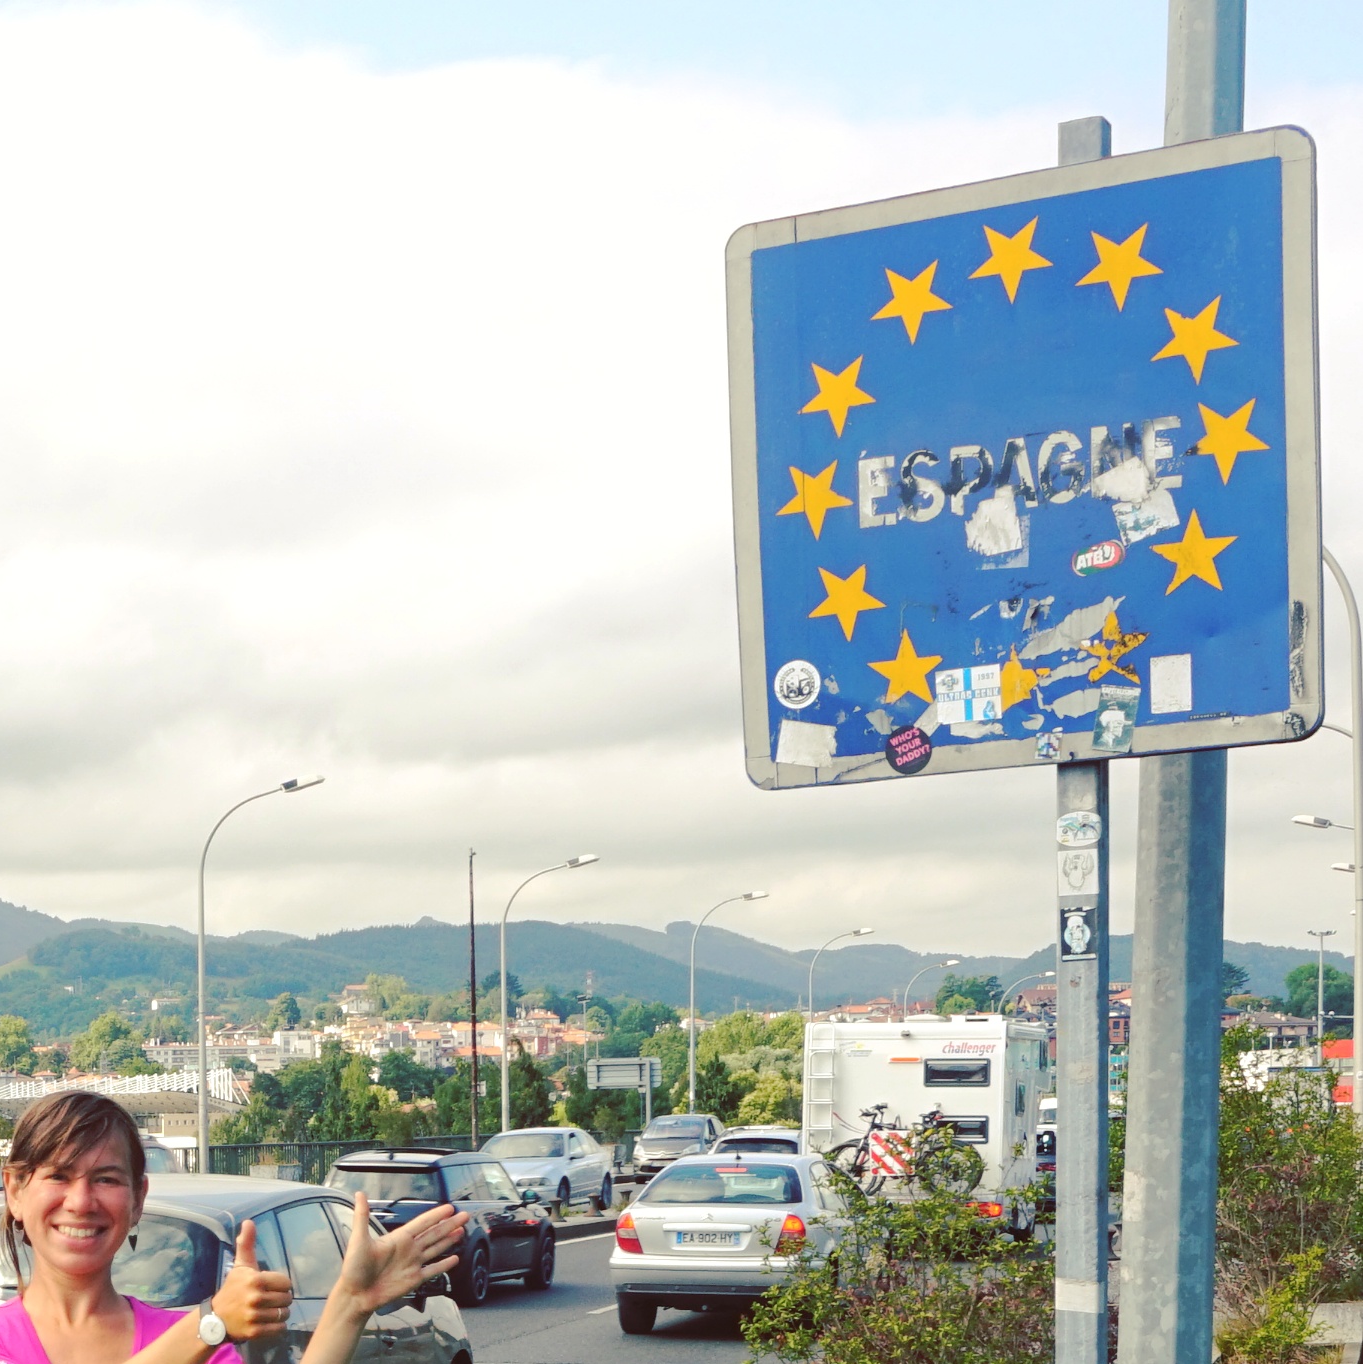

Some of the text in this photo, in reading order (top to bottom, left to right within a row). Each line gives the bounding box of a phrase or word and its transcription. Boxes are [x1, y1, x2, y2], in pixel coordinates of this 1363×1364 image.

[858, 416, 1183, 528] ESPAGNE
[977, 672, 995, 682] 1997
[889, 727, 920, 747] WHO'S
[895, 737, 922, 755] YOUR
[896, 744, 930, 766] DADDY?
[942, 1041, 996, 1056] challenger
